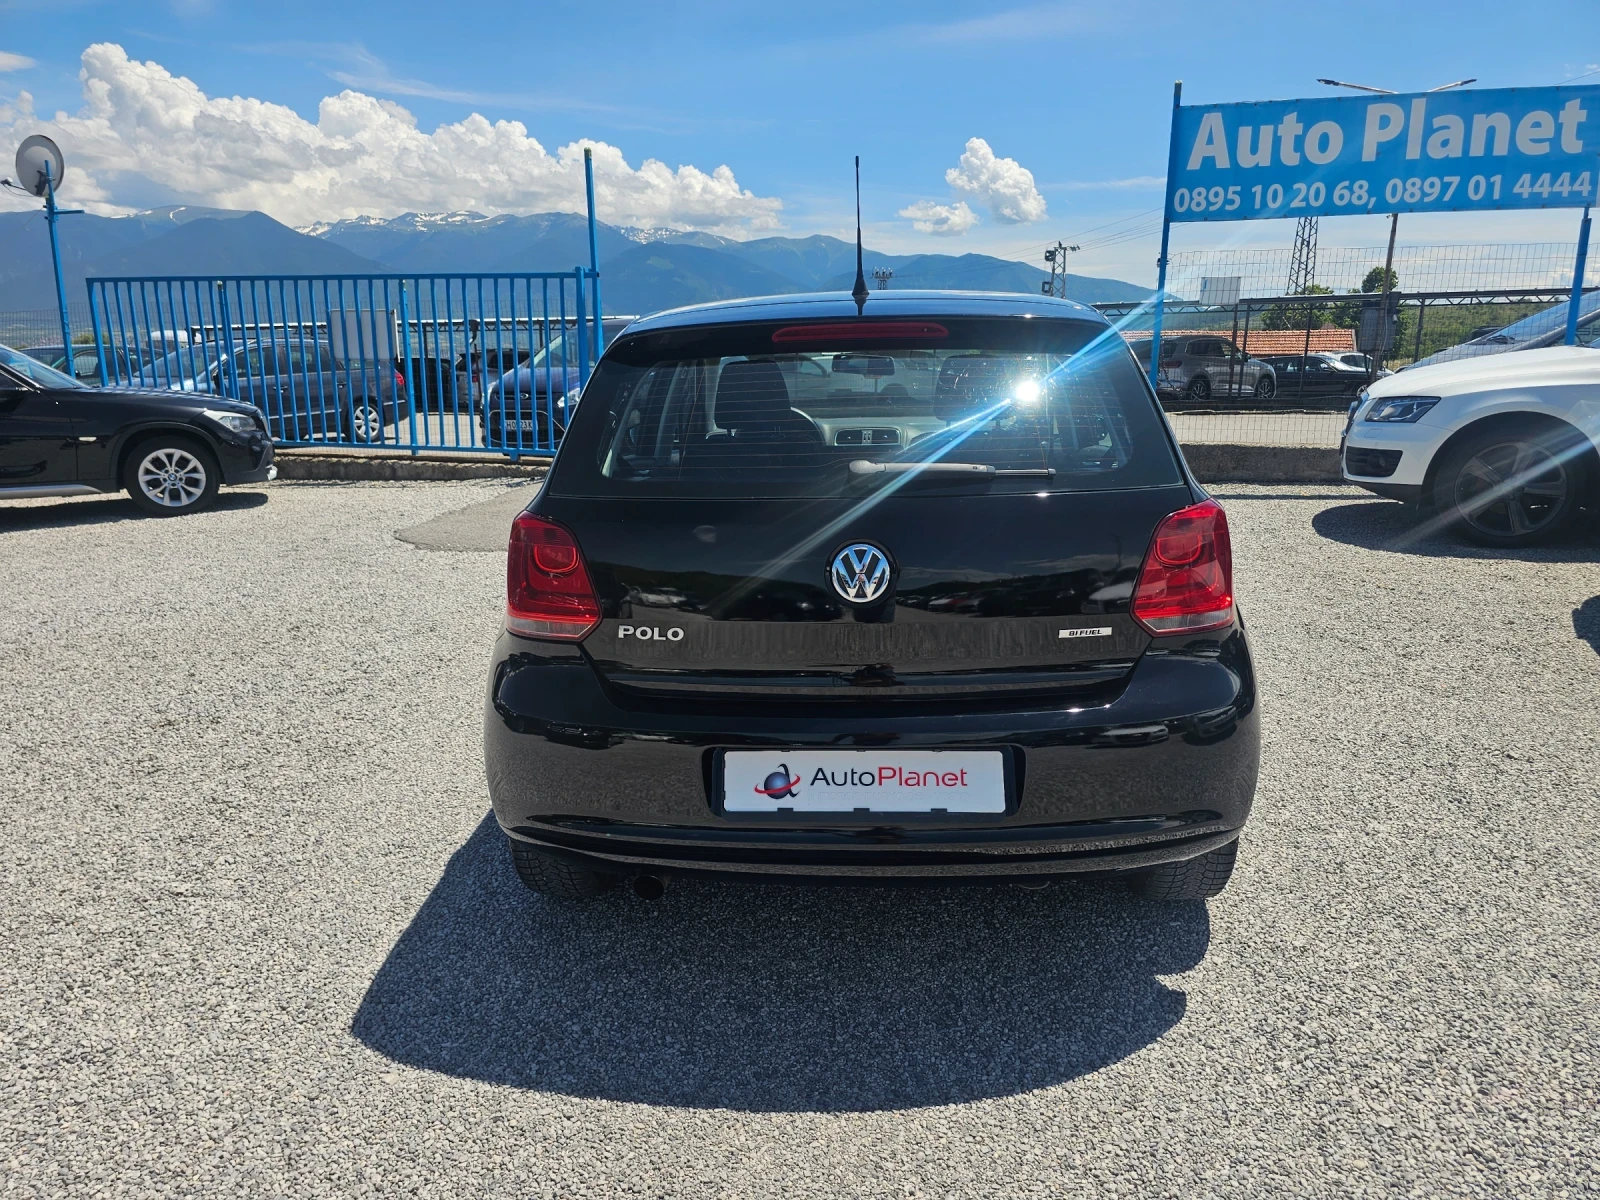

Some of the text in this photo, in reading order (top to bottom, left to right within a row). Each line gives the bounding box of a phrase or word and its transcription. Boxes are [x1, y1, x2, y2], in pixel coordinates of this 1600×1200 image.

[1186, 97, 1587, 170] Auto Planet
[1173, 171, 1592, 213] 0895 10 20 68, 0897 01 4444
[618, 624, 684, 641] POLO
[810, 766, 968, 787] AutoPlanet
